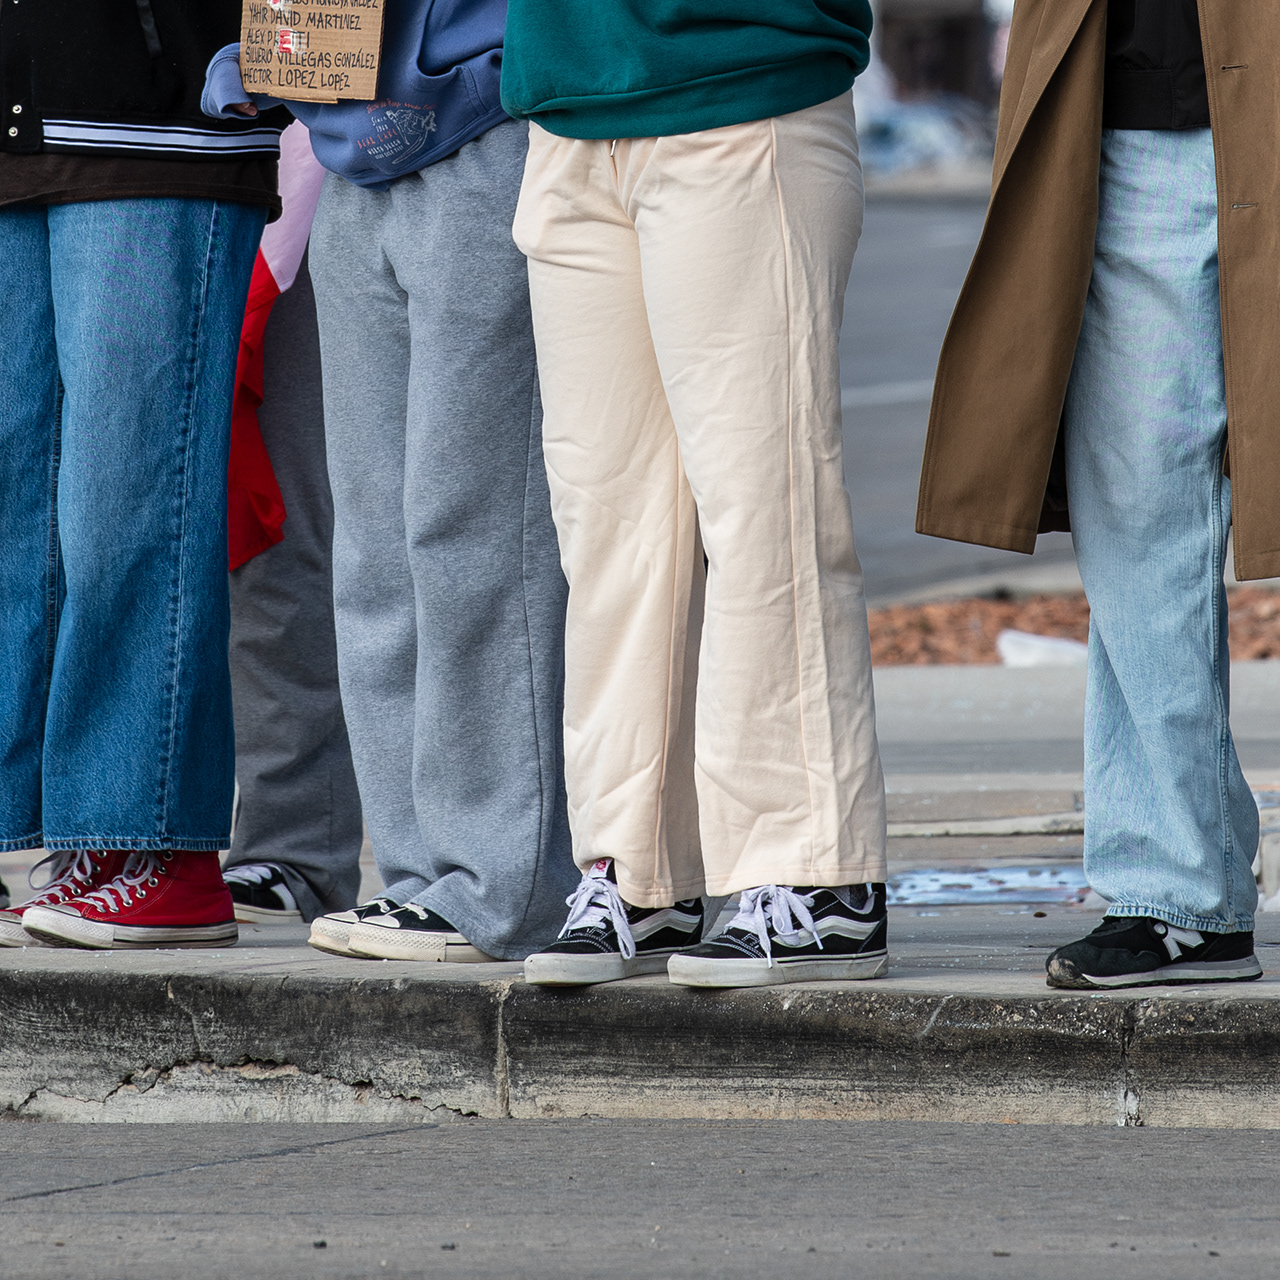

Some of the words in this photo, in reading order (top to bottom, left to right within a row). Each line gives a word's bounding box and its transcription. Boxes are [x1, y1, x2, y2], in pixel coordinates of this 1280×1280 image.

[271, 7, 301, 27] DAVID
[305, 12, 361, 30] MARTINEZ
[247, 28, 265, 45] ALEX
[277, 51, 332, 68] VILLEGAS
[243, 67, 272, 85] HECTOR
[278, 68, 317, 89] LOPEZ
